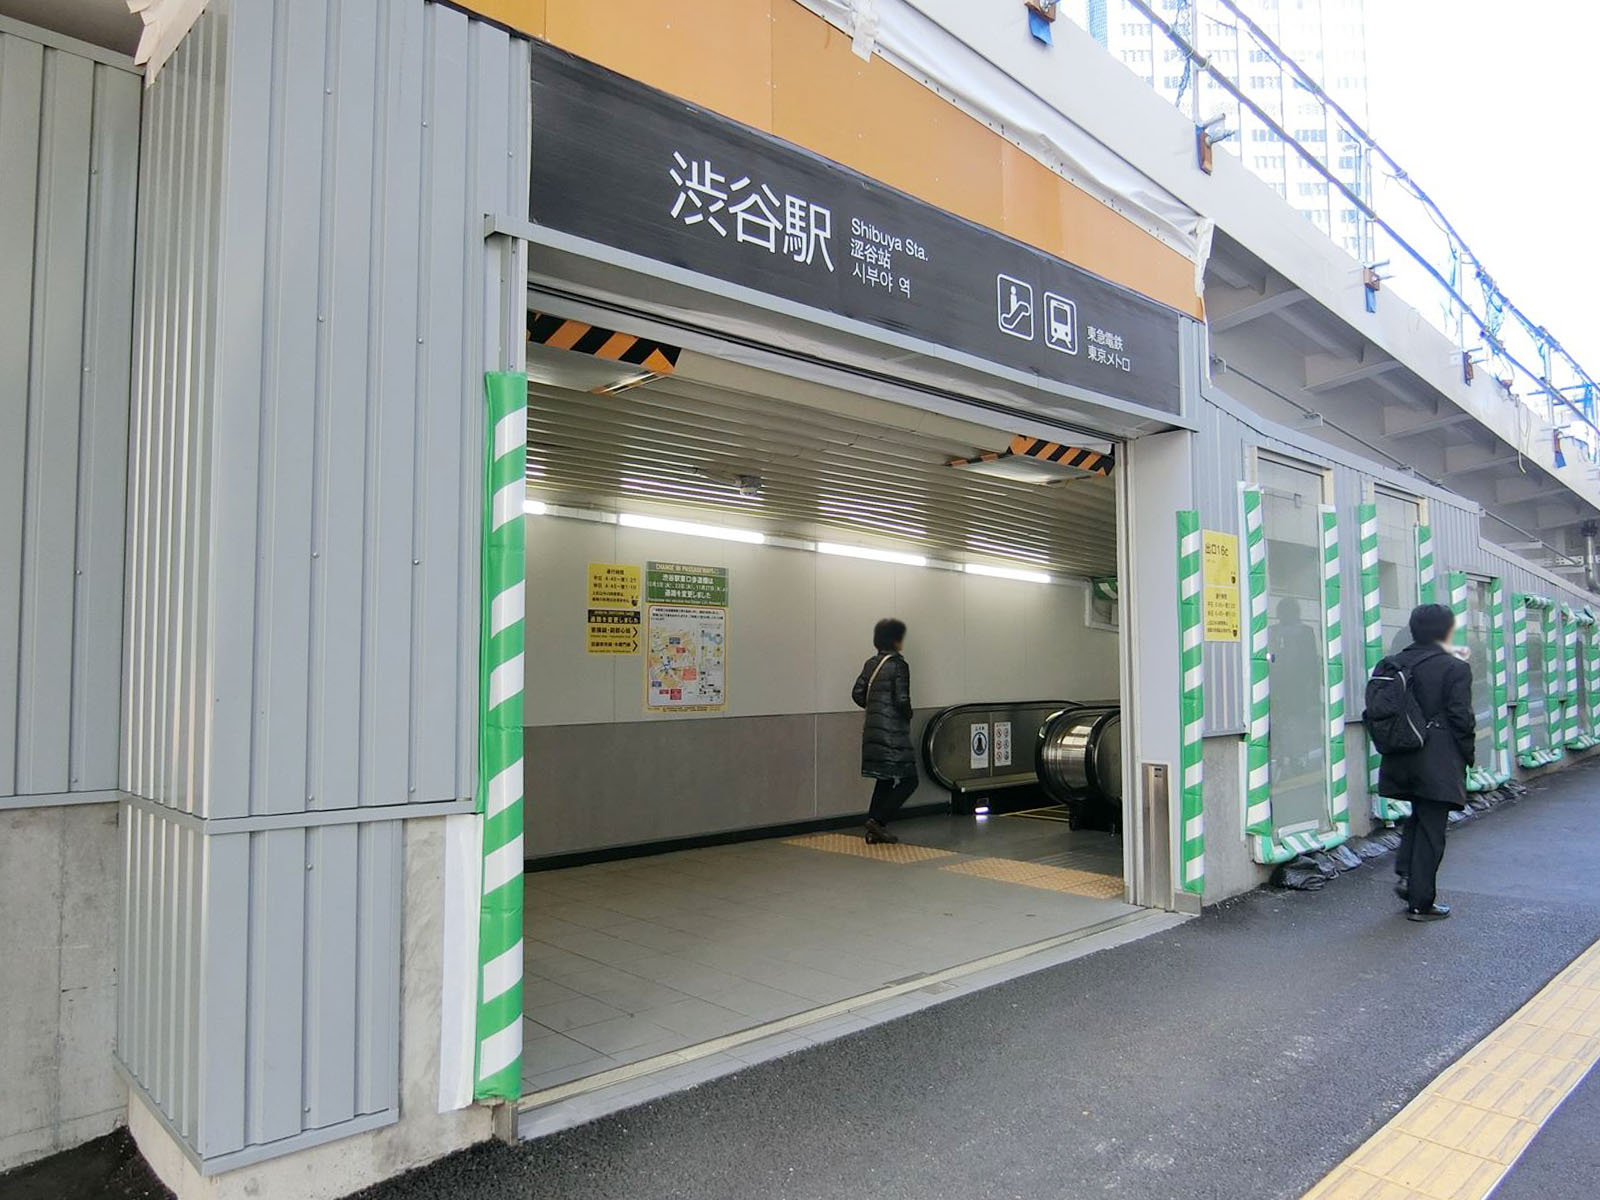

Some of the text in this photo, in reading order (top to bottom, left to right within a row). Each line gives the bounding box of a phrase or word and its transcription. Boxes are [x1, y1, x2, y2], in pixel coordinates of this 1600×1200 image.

[669, 151, 834, 272] 渋谷駅
[851, 217, 929, 261] Shibuya Sta.
[852, 262, 911, 298] 시부야 역
[1087, 325, 1124, 351] 東急電鉄
[1087, 345, 1131, 371] 東京メトロ
[1205, 543, 1229, 557] 出口16c
